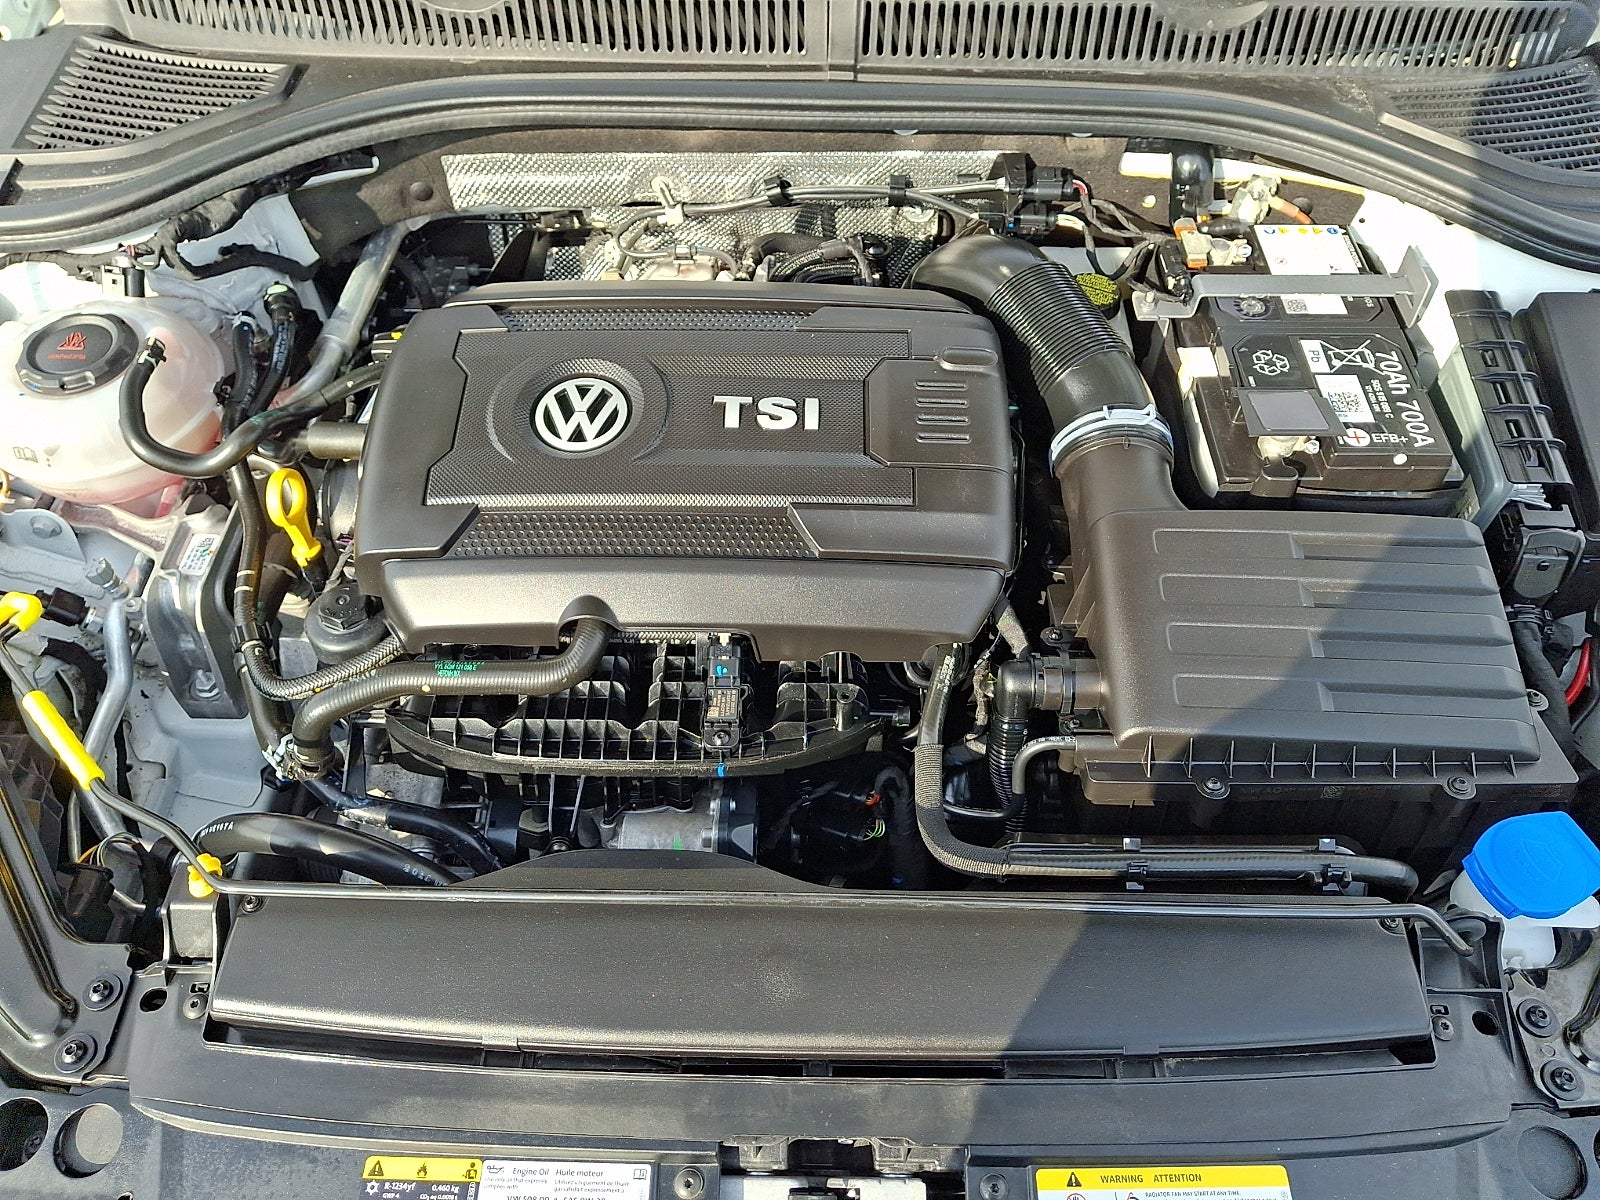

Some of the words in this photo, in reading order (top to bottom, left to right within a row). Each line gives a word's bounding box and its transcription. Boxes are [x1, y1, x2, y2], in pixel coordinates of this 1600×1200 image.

[1308, 350, 1320, 363] Pb
[1375, 350, 1412, 395] 70Ah
[1396, 399, 1436, 448] 700A
[713, 395, 820, 431] TSI
[1371, 433, 1409, 443] EFB+
[512, 1167, 538, 1177] Engine
[538, 1168, 550, 1176] Oil
[555, 1168, 575, 1176] Huile
[1100, 1174, 1144, 1184] WARNING
[1153, 1173, 1202, 1183] ATTENTION
[383, 1181, 417, 1192] R-1234yf
